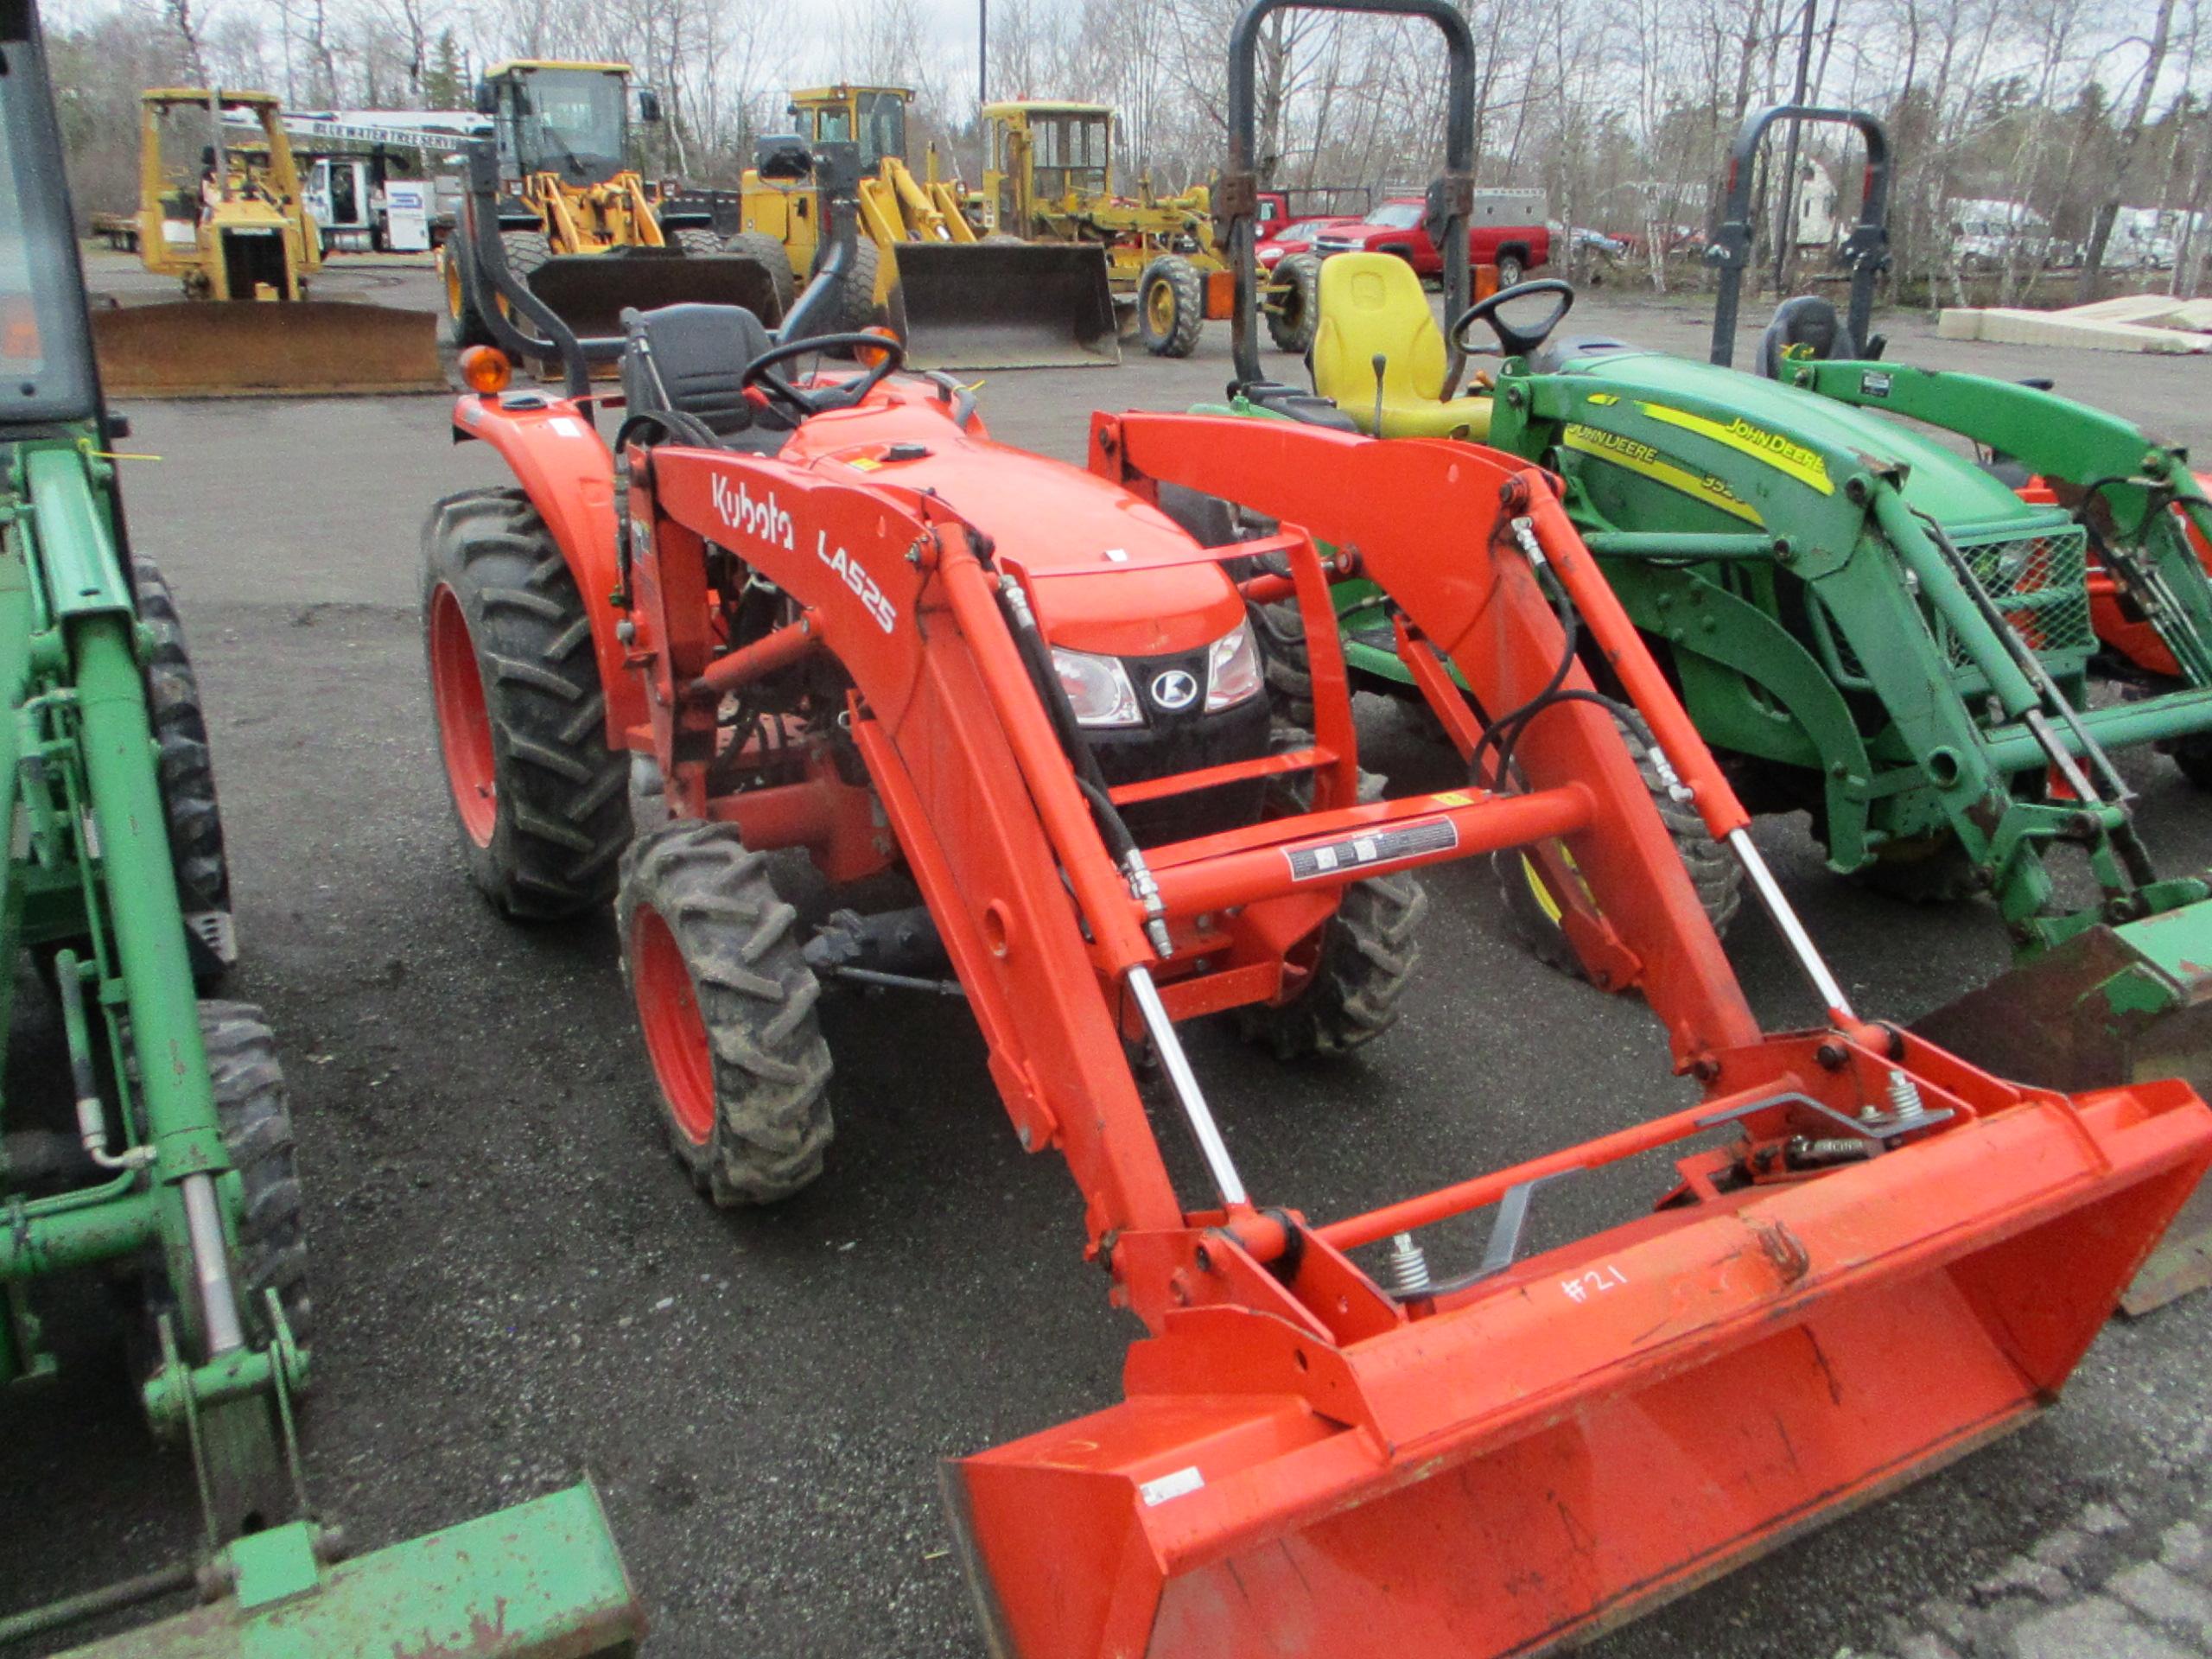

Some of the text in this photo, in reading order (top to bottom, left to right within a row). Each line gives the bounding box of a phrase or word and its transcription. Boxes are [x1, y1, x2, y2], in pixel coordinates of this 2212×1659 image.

[1726, 417, 1825, 473] JOHN DEERE
[711, 472, 794, 550] Kubota
[817, 529, 898, 634] LA525
[1560, 1264, 1629, 1303] #21
